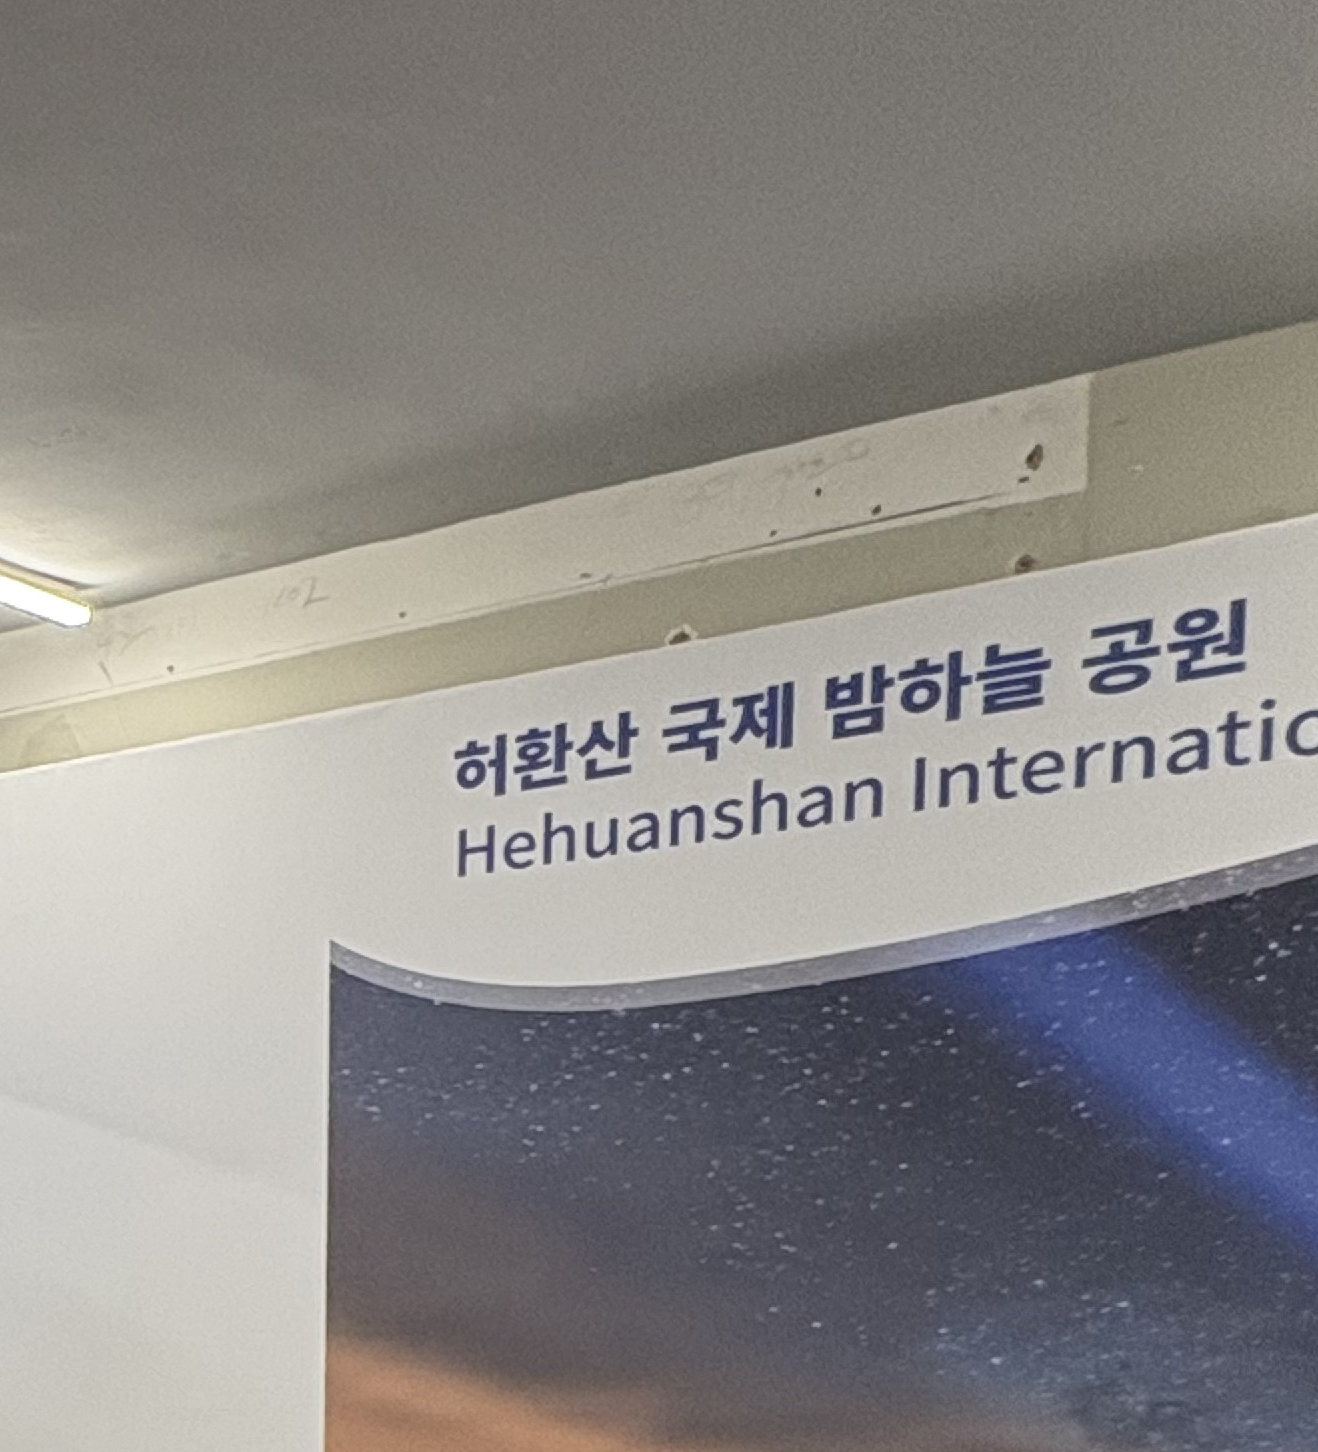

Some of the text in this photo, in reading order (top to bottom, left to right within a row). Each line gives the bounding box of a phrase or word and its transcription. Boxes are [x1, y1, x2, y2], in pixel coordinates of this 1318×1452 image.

[453, 597, 1247, 797] 허환산 국제 밤하늘 공원
[456, 773, 885, 876] Hehuanshan
